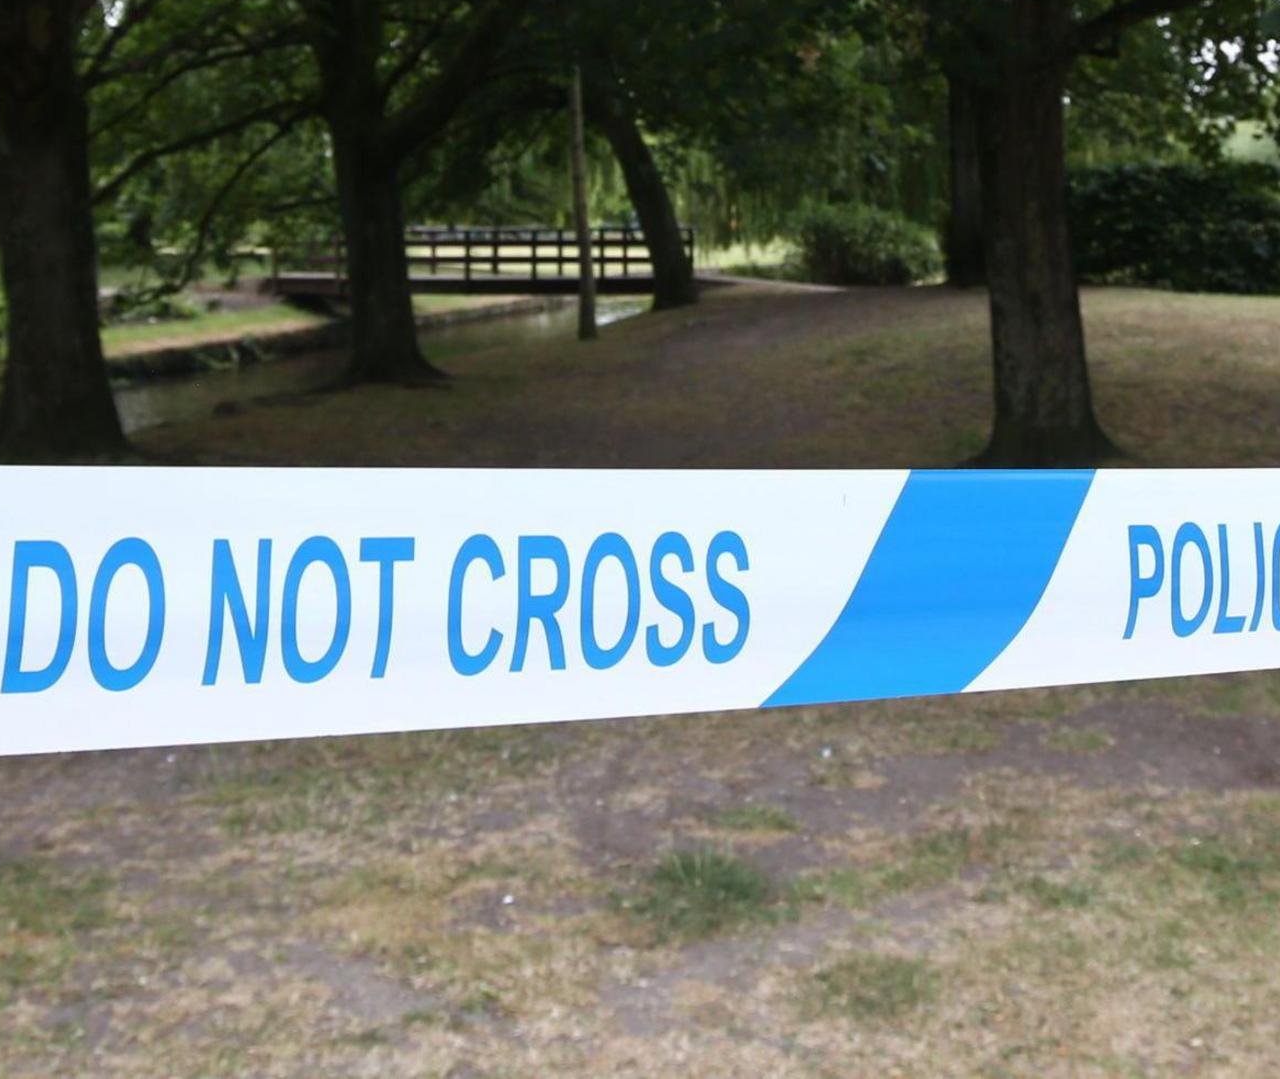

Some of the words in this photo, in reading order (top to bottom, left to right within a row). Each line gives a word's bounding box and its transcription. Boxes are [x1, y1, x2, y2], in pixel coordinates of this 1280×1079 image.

[0, 535, 166, 695] DO
[201, 533, 416, 687] NOT
[447, 529, 751, 677] CROSS
